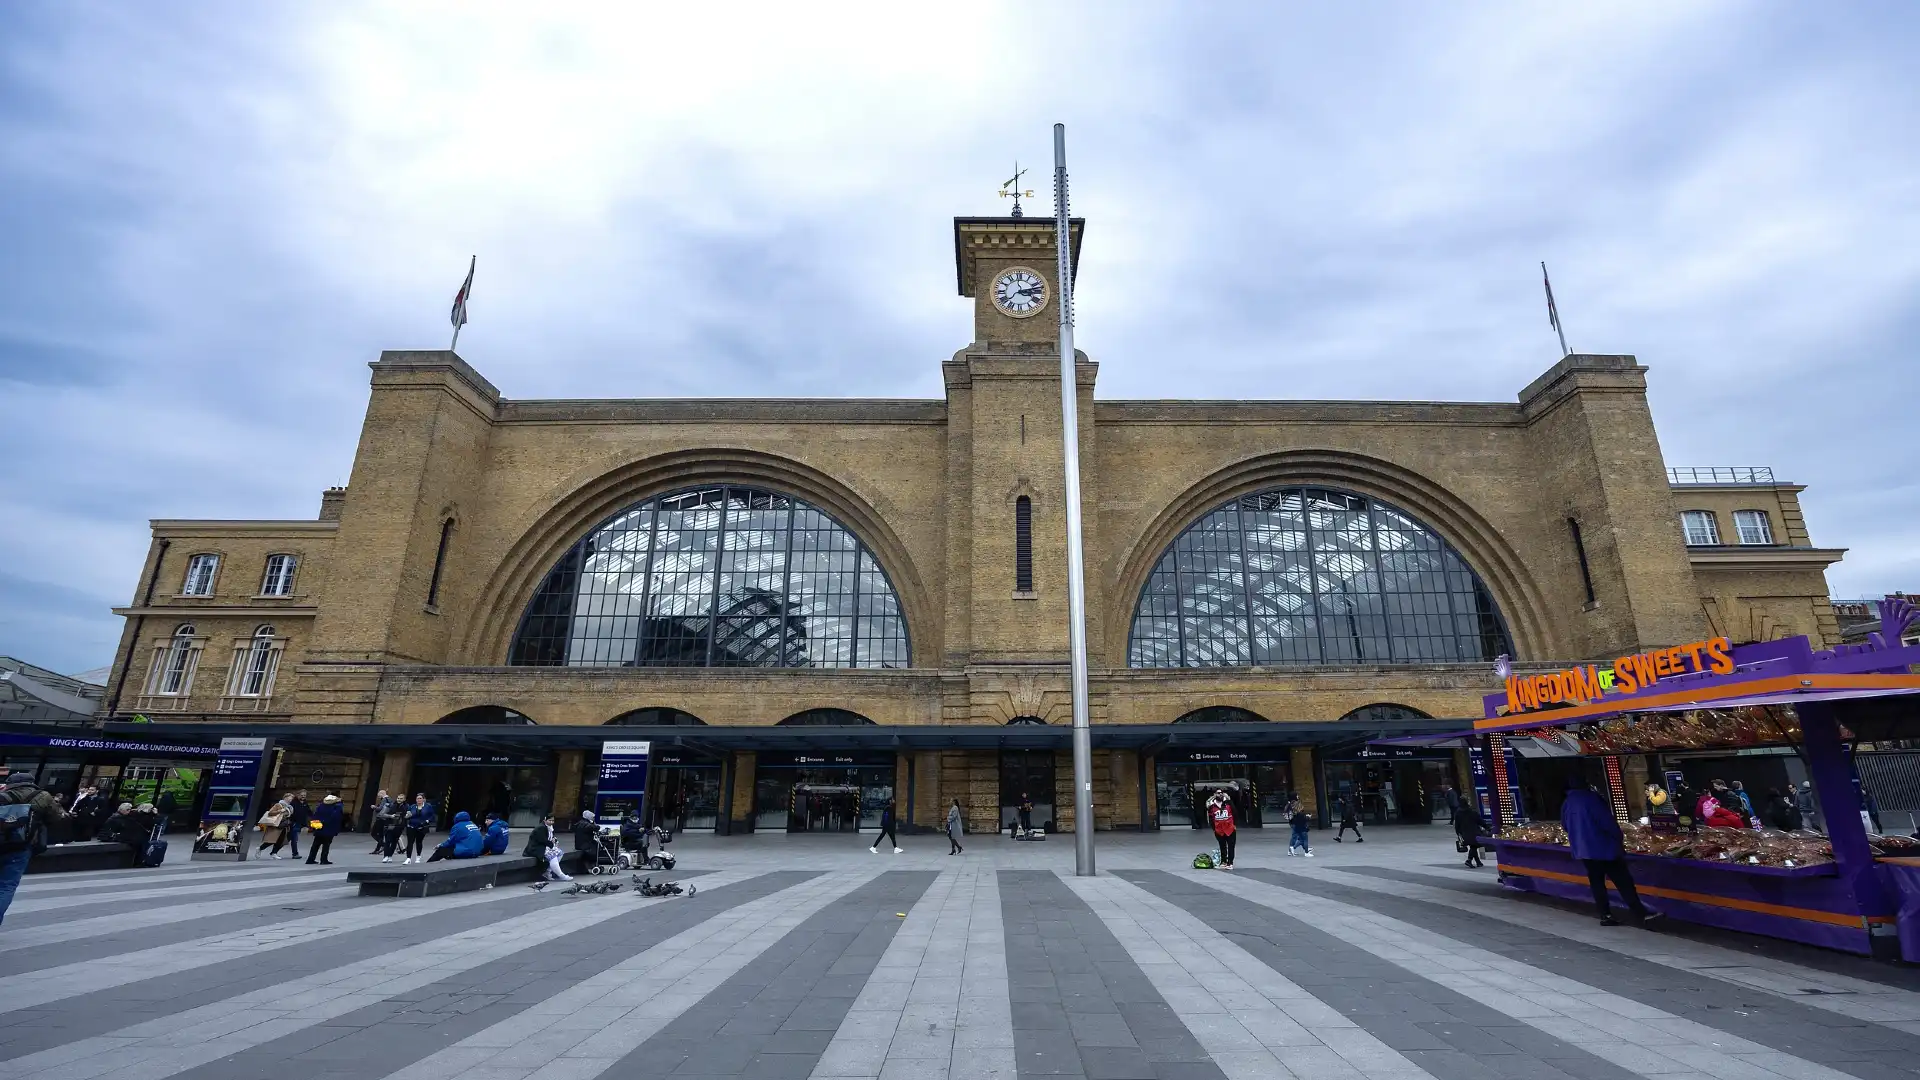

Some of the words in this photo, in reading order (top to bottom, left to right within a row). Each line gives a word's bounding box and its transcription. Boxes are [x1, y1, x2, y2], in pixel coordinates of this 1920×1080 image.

[1505, 664, 1603, 713] KINGDOM
[1598, 668, 1615, 690] OF
[1614, 636, 1736, 694] SWEETS
[49, 738, 77, 747] KING'S
[78, 739, 104, 748] CROSS
[115, 742, 149, 751] PANCRAS
[150, 744, 201, 754] UNDERGROUND
